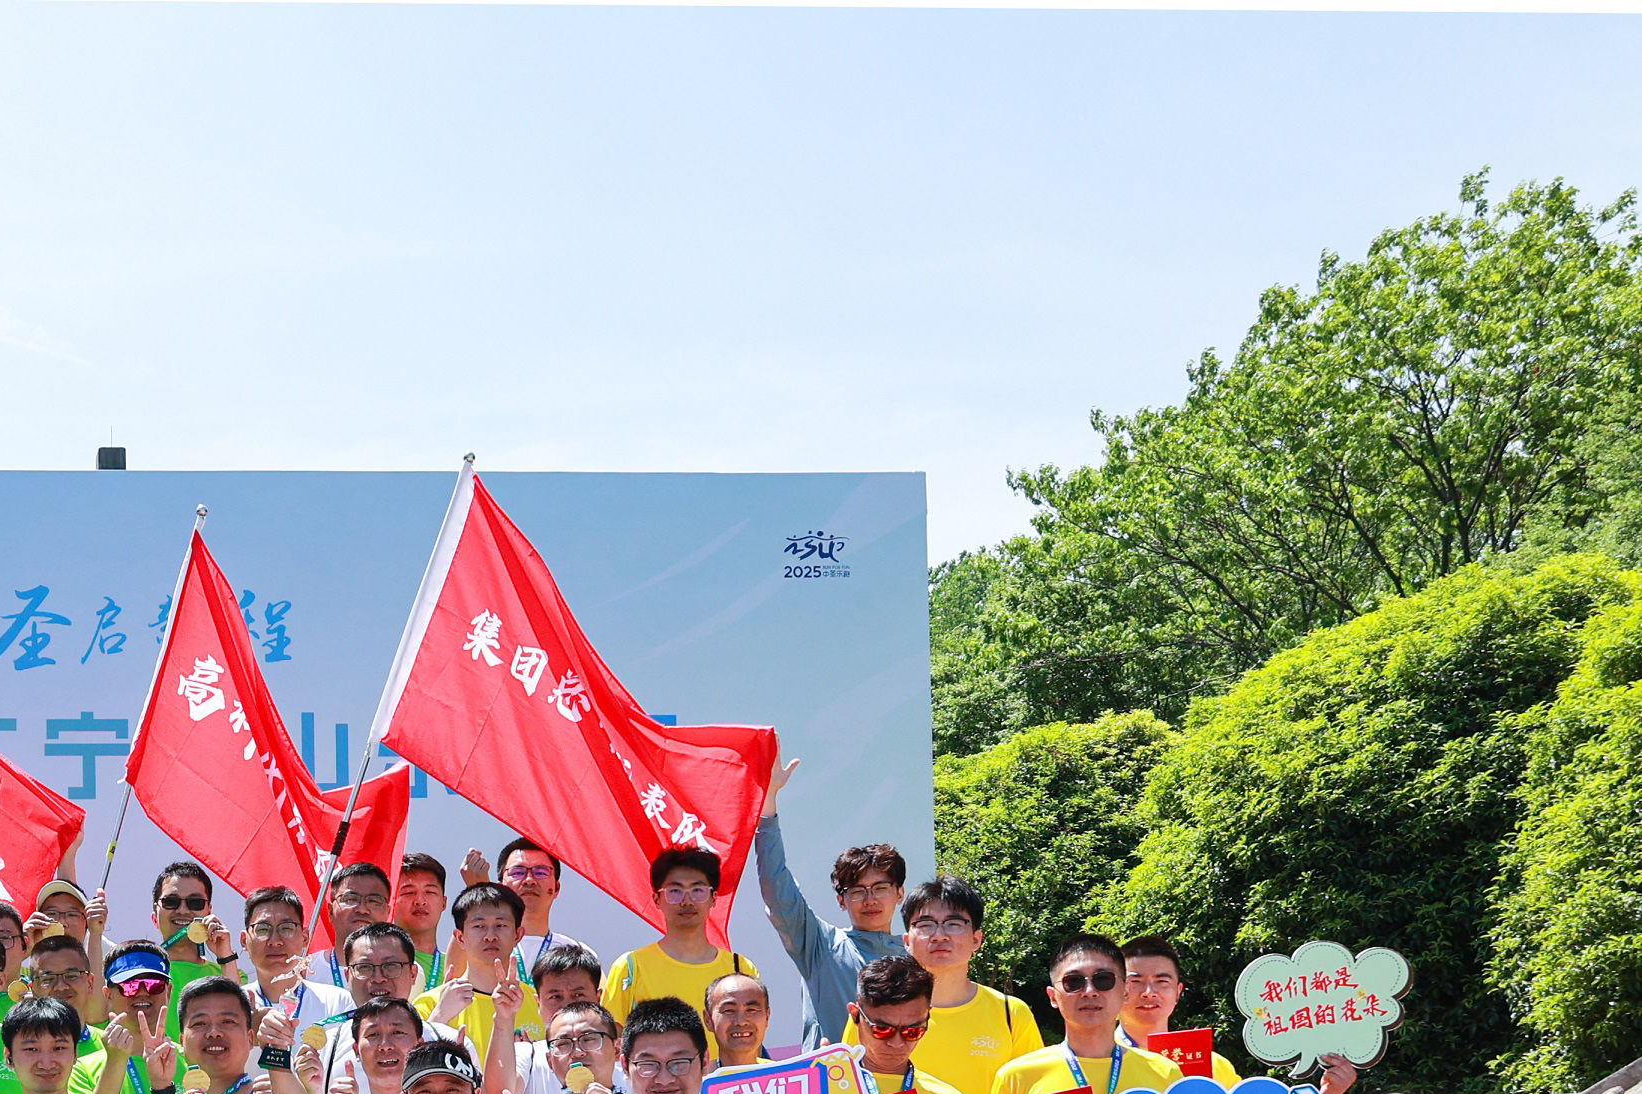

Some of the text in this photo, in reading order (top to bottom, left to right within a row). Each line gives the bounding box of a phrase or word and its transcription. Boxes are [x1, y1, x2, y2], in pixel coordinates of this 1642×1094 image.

[784, 566, 822, 578] 2025
[1259, 967, 1359, 1003] 我们都是
[1263, 993, 1388, 1036] 祖国的花朵
